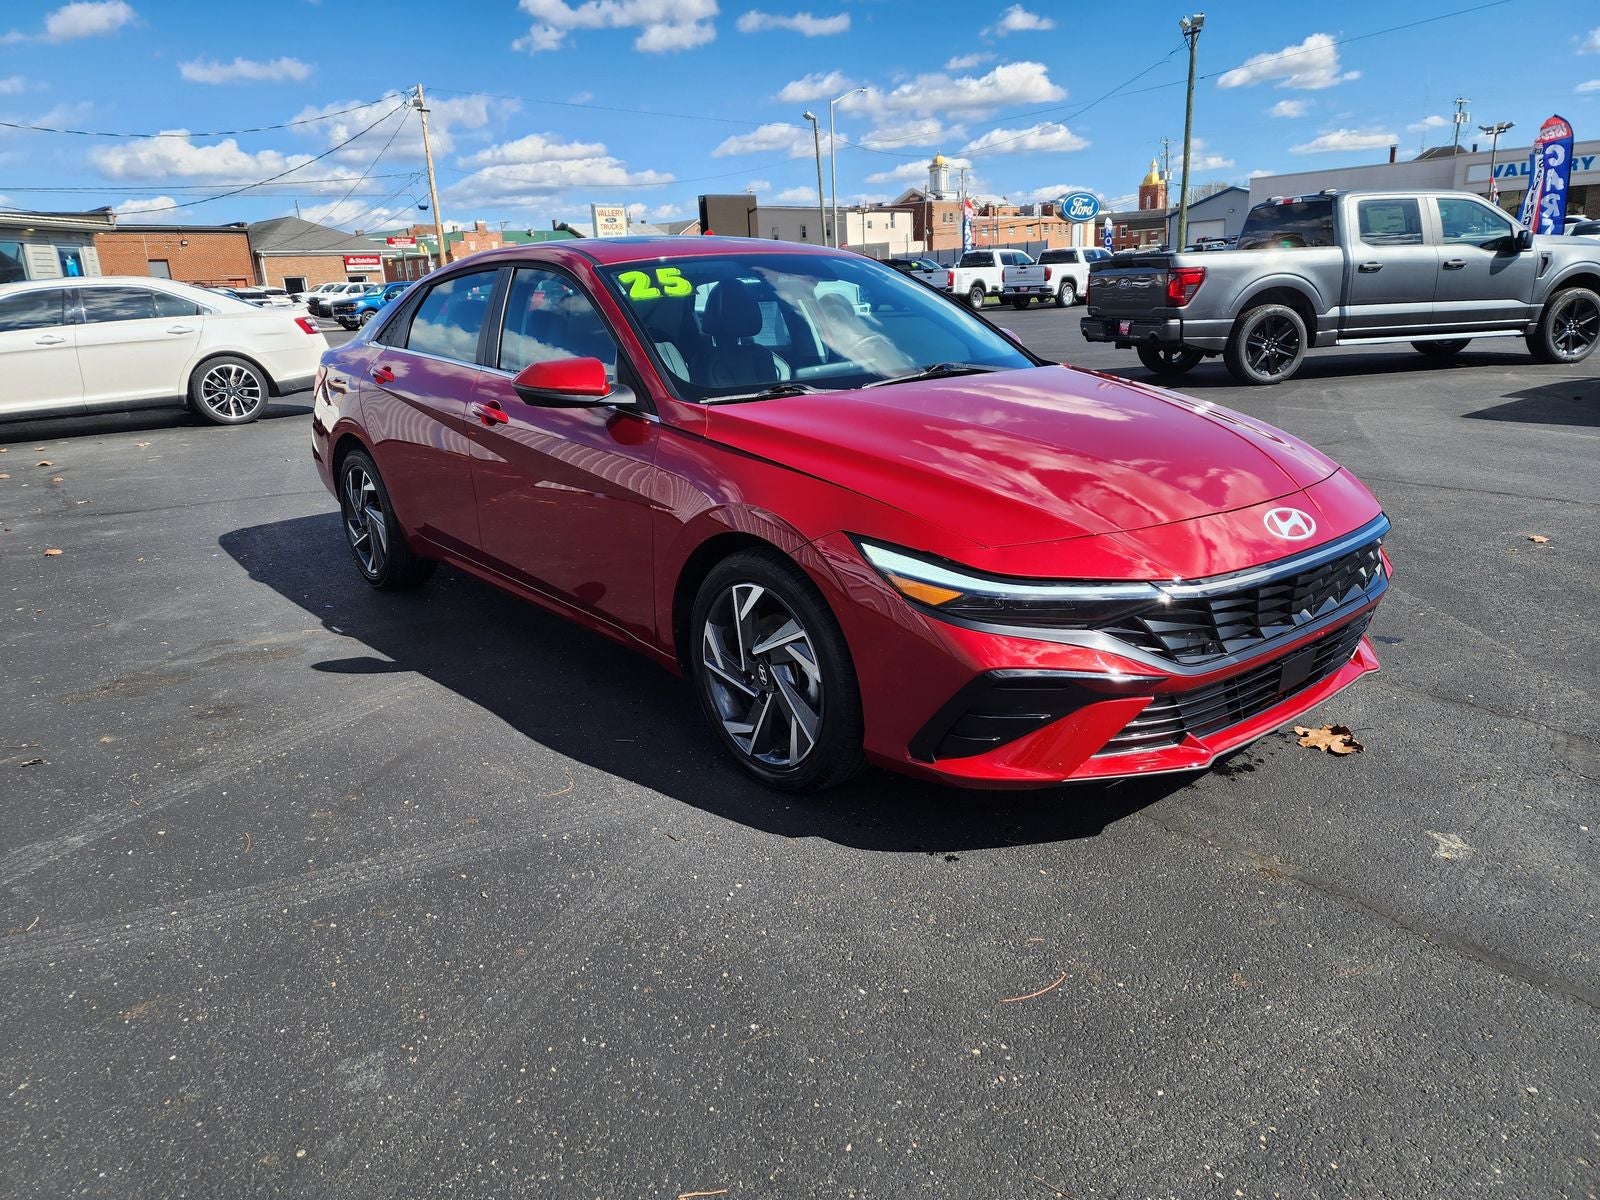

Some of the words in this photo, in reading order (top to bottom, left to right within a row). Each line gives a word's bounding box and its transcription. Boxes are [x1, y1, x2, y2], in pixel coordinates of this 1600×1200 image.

[1070, 197, 1095, 215] Ford
[597, 209, 624, 217] VALLERY
[600, 223, 624, 231] TRUCKS
[618, 267, 693, 300] 25
